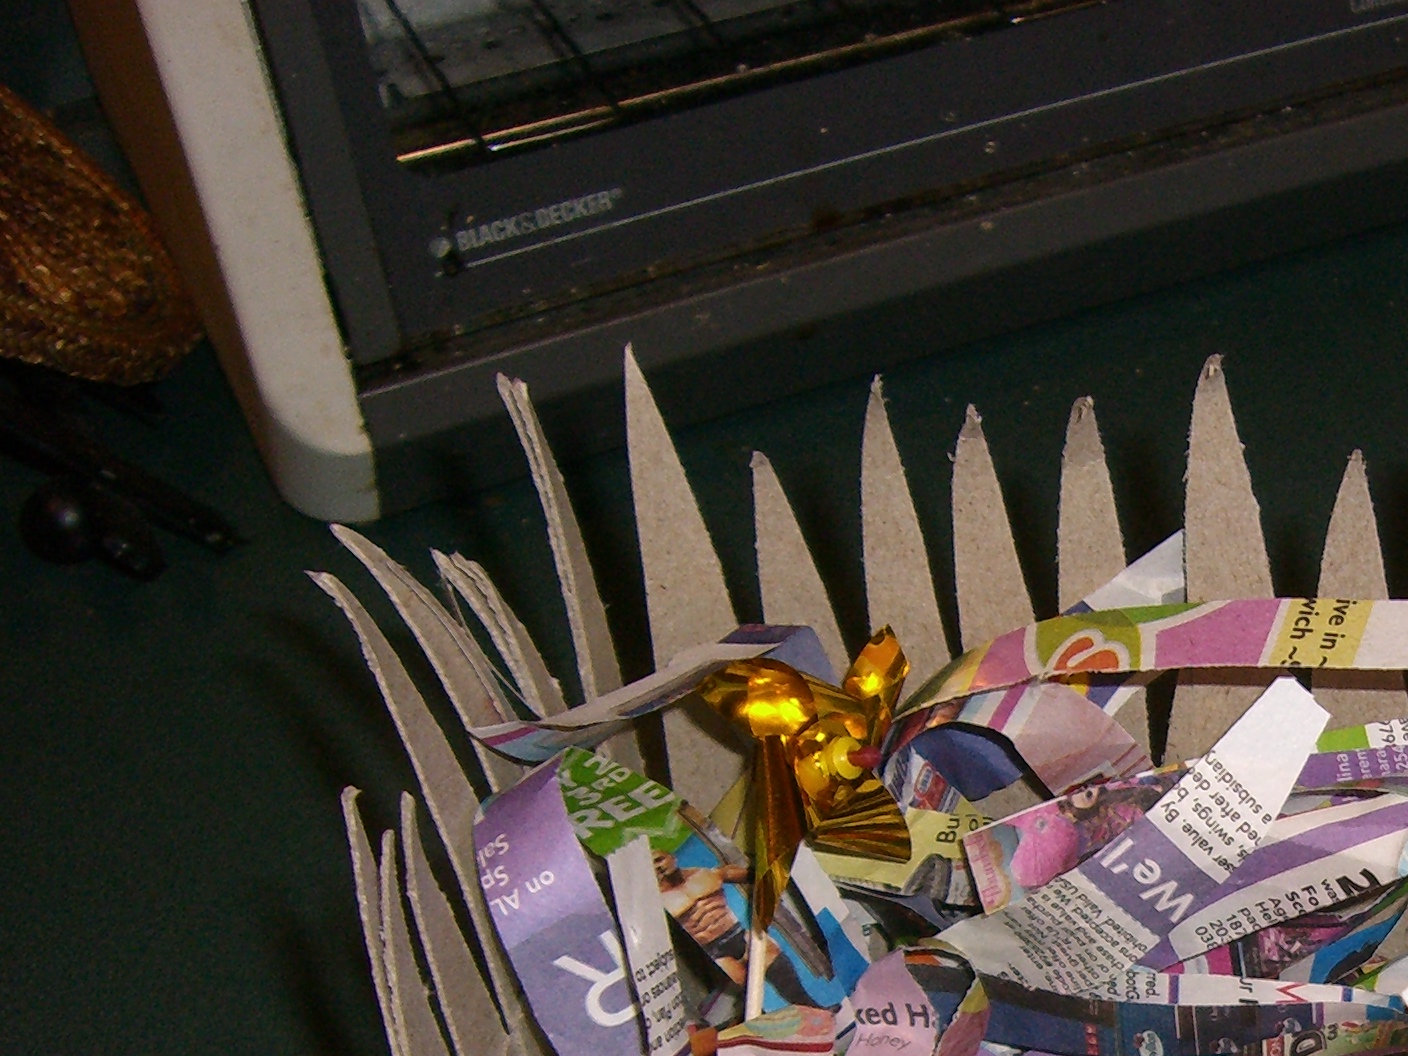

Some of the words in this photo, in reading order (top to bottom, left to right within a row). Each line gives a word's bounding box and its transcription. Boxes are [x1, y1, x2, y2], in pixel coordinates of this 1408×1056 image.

[1159, 799, 1182, 822] By
[1207, 790, 1242, 824] after
[525, 869, 558, 896] on
